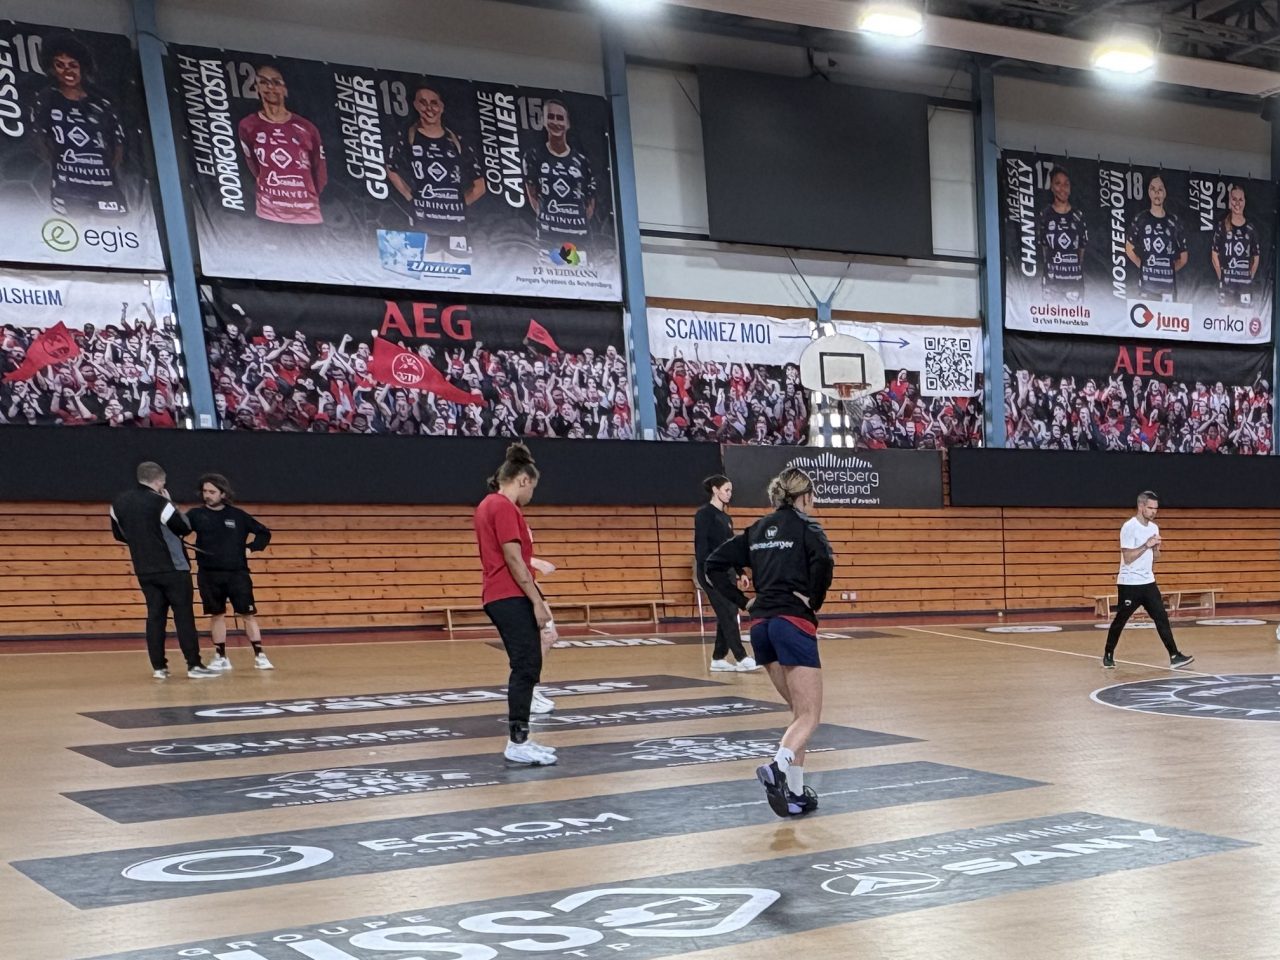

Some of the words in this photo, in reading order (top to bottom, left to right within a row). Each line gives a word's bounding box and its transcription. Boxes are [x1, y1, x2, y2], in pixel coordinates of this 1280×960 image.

[225, 61, 259, 99] 12
[379, 80, 409, 117] 13
[517, 96, 544, 131] 15
[352, 75, 390, 200] GUERRIER
[477, 90, 503, 195] CORENTINE
[493, 91, 525, 209] CAVALIER
[1126, 172, 1143, 201] 18
[1017, 159, 1037, 277] CHANTELLY
[1200, 180, 1214, 232] VLUG
[84, 226, 140, 253] egis
[1110, 170, 1127, 300] MOSTEFAOUI
[379, 300, 473, 341] AEG
[1030, 303, 1091, 319] cuisinella
[1156, 311, 1190, 332] jung
[665, 317, 738, 343] SCANNEZ
[740, 323, 771, 345] MOI
[1113, 345, 1174, 377] AEG
[800, 467, 880, 487] chersberg
[194, 690, 510, 717] Grand
[193, 727, 451, 752] Butagaz
[313, 780, 429, 799] LAIT
[357, 811, 633, 852] EQIOM
[483, 825, 615, 846] COMPANY
[810, 820, 1104, 874] CONCESSIONNAIRE
[941, 828, 1171, 876] SANY
[178, 913, 431, 957] GROUPE
[563, 940, 632, 960] TP
